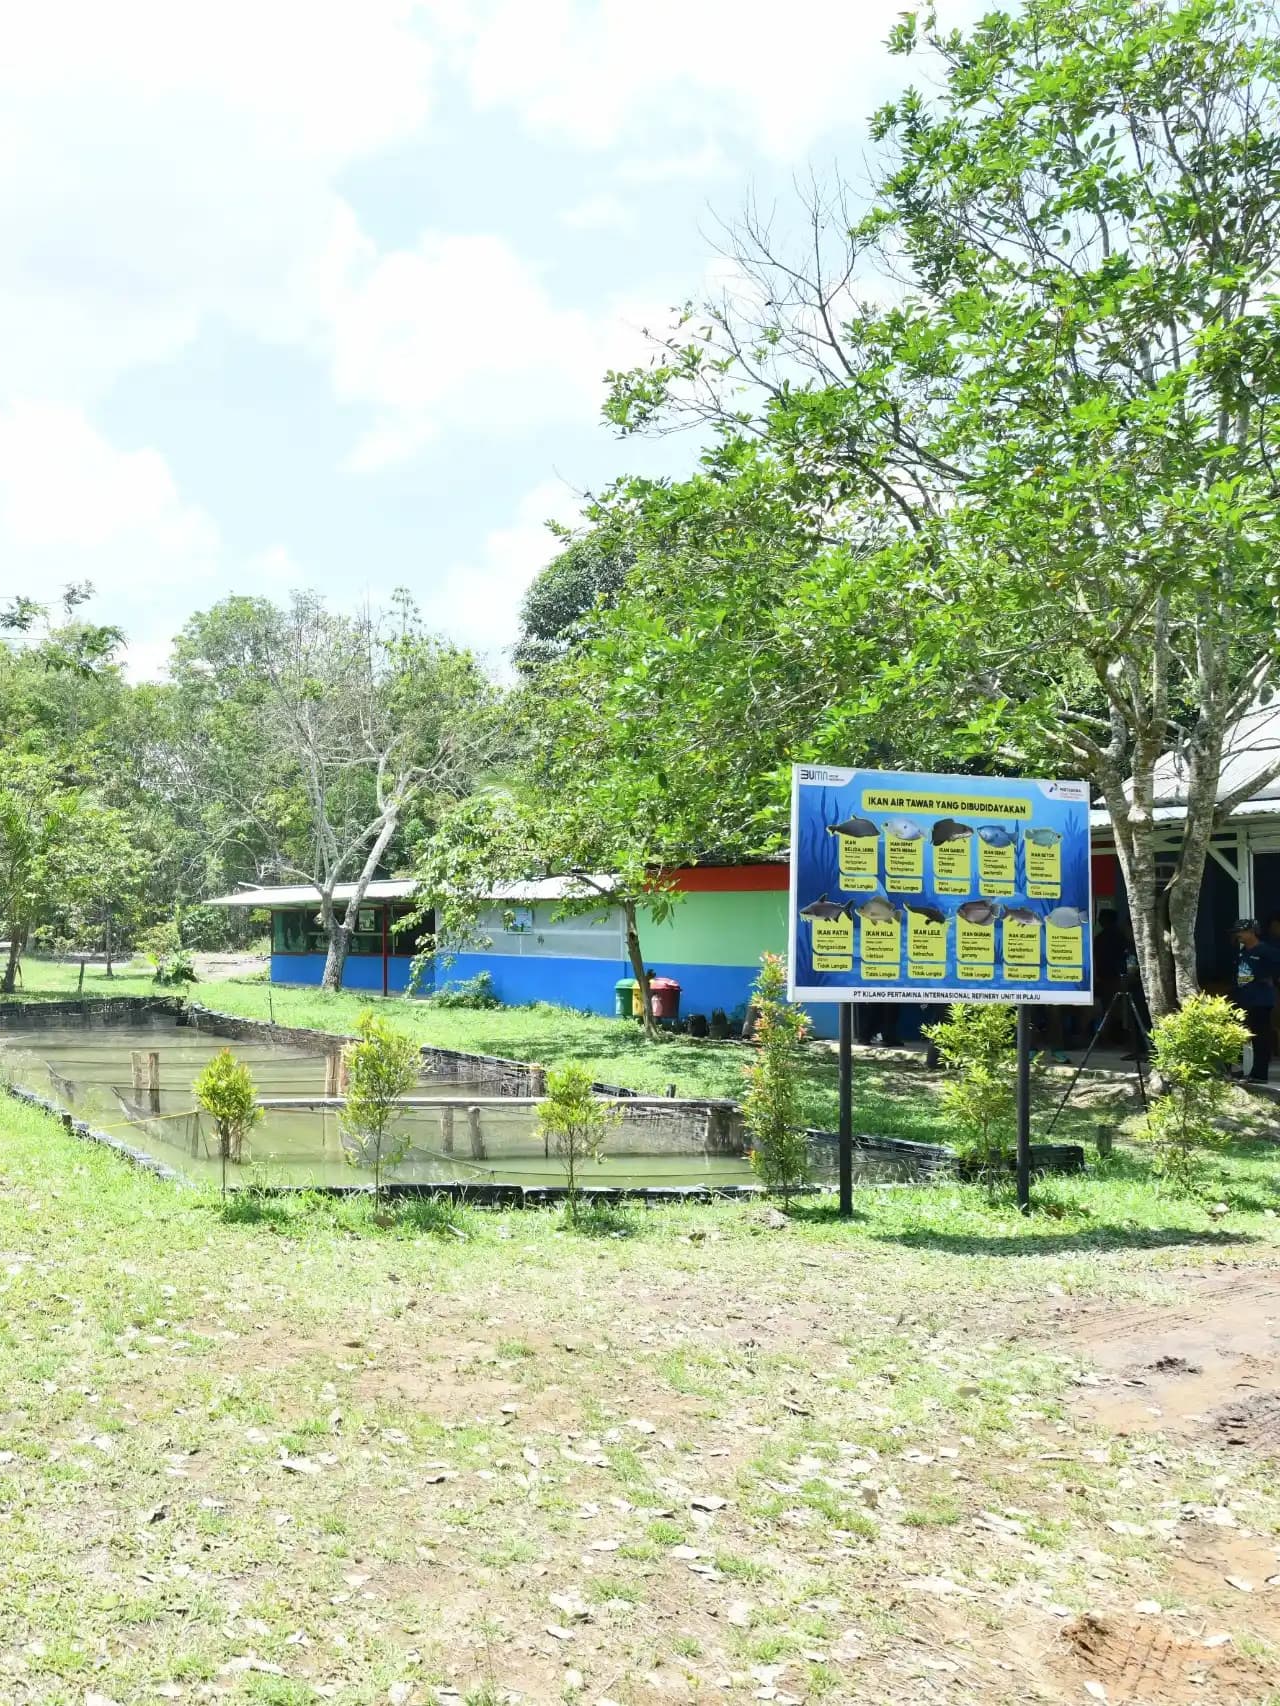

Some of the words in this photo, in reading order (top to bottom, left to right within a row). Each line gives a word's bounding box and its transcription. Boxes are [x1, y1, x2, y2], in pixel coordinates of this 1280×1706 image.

[868, 797, 889, 806] IKAN
[890, 798, 904, 807] AIR
[907, 799, 934, 809] TAWAR
[935, 800, 959, 810] YANG
[961, 802, 1026, 814] DIBUDIDAYAKAN
